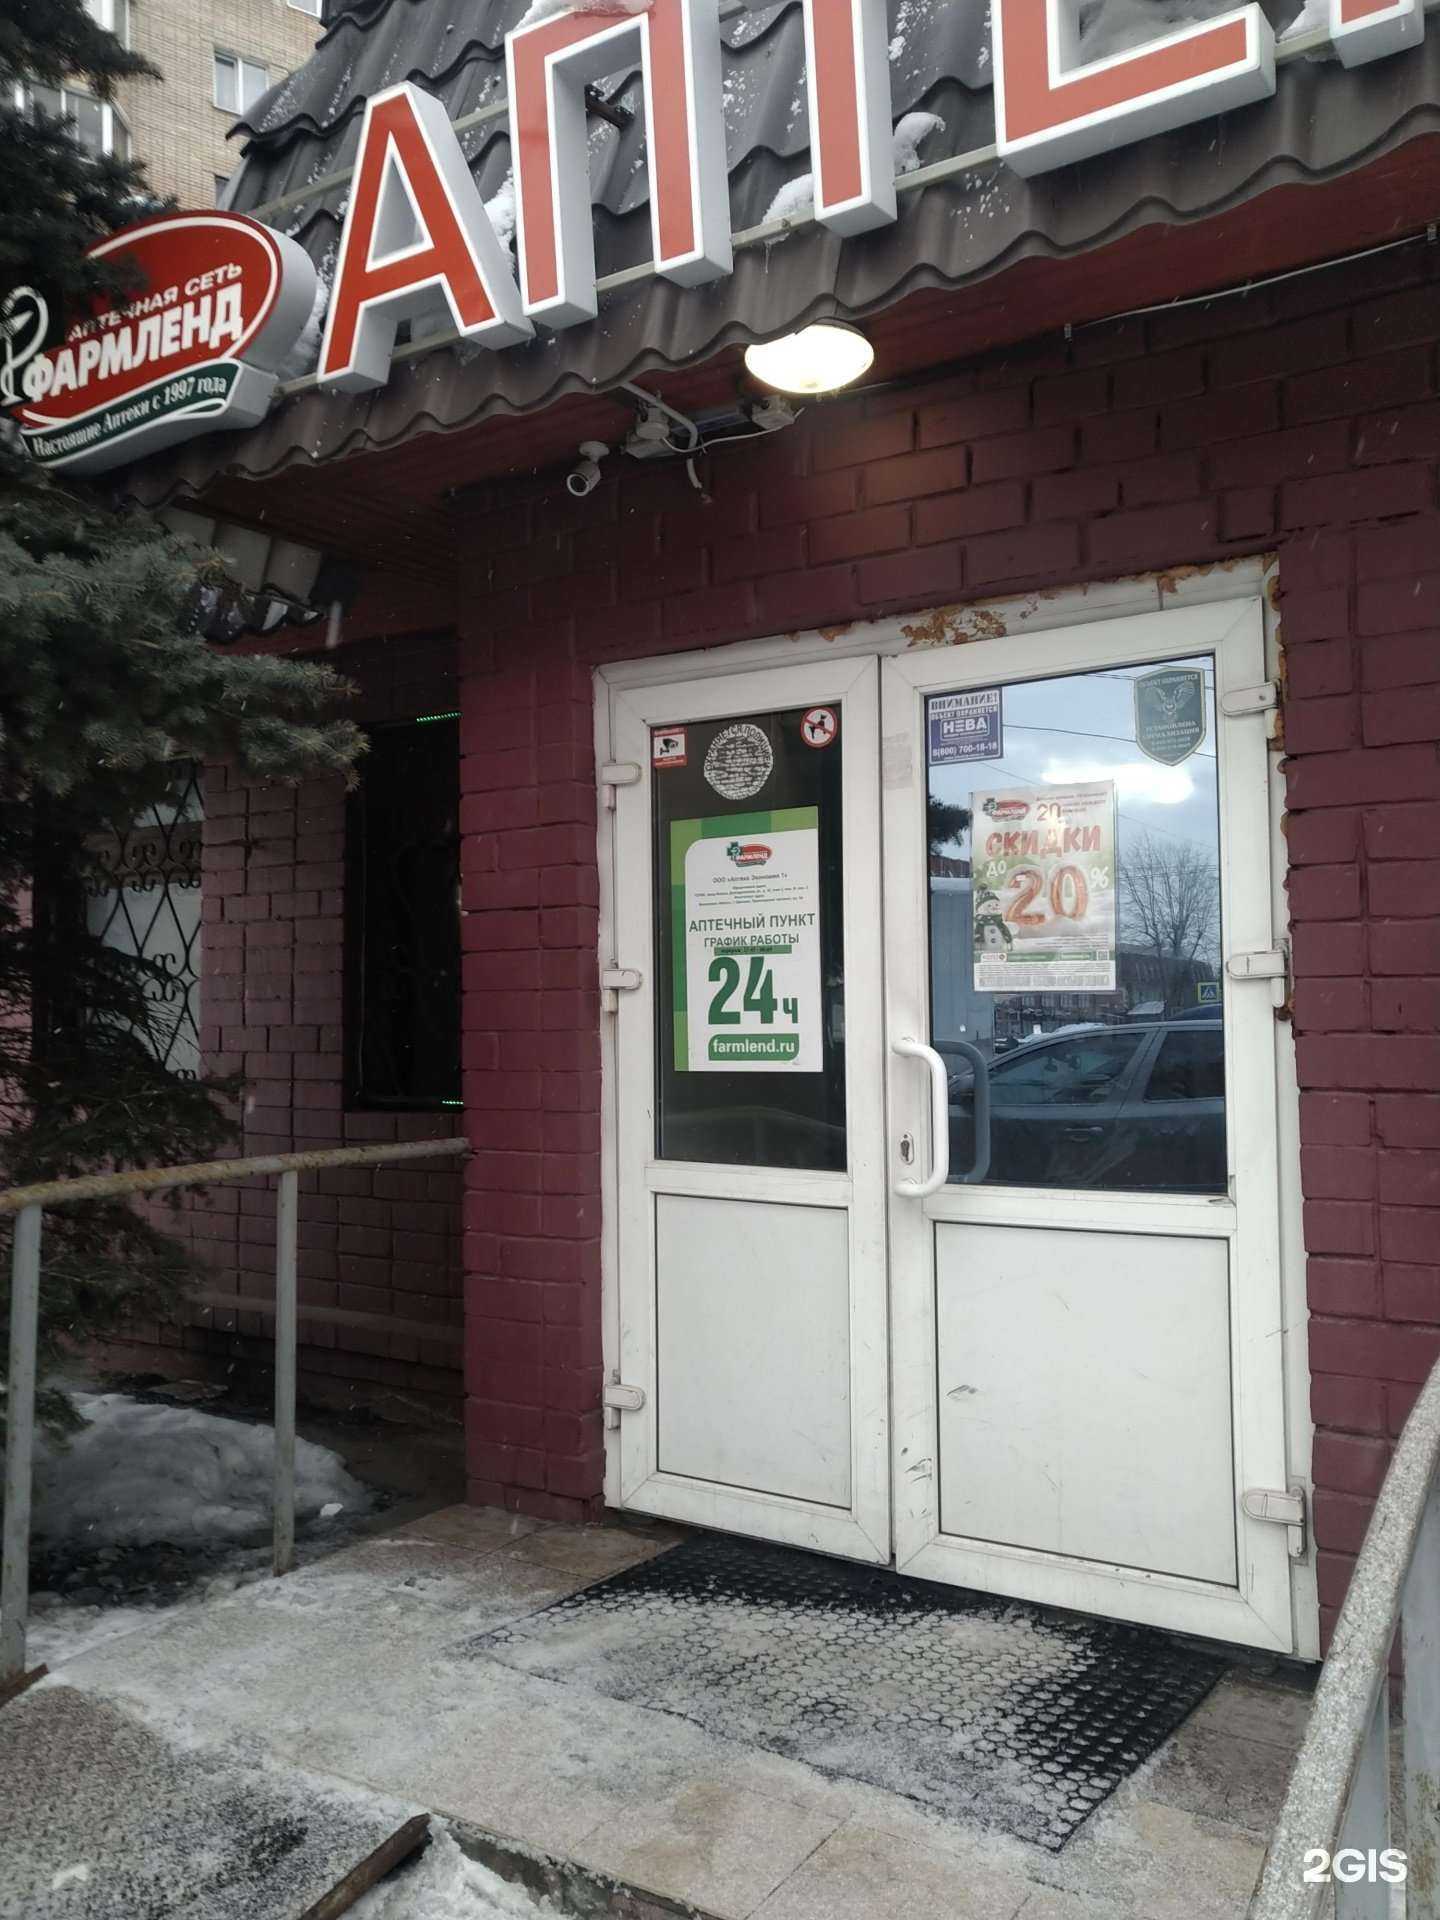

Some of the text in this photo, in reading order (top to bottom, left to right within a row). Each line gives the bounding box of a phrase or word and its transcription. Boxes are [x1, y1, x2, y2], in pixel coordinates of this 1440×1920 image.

[184, 262, 243, 297] СЕТЬ
[22, 282, 244, 402] ФАРМЛЕНД
[101, 402, 150, 432] Аптеки
[152, 397, 161, 411] с
[163, 376, 195, 406] 1997
[197, 376, 227, 395] года
[943, 717, 987, 734] НЕВА
[986, 825, 1101, 858] СКИДКИ
[689, 912, 816, 933] АПТЕЧНЫЙ ПУНКТ
[704, 933, 800, 948] ГРАФИК РАБОТЫ
[713, 1038, 795, 1053] farmlend.ru
